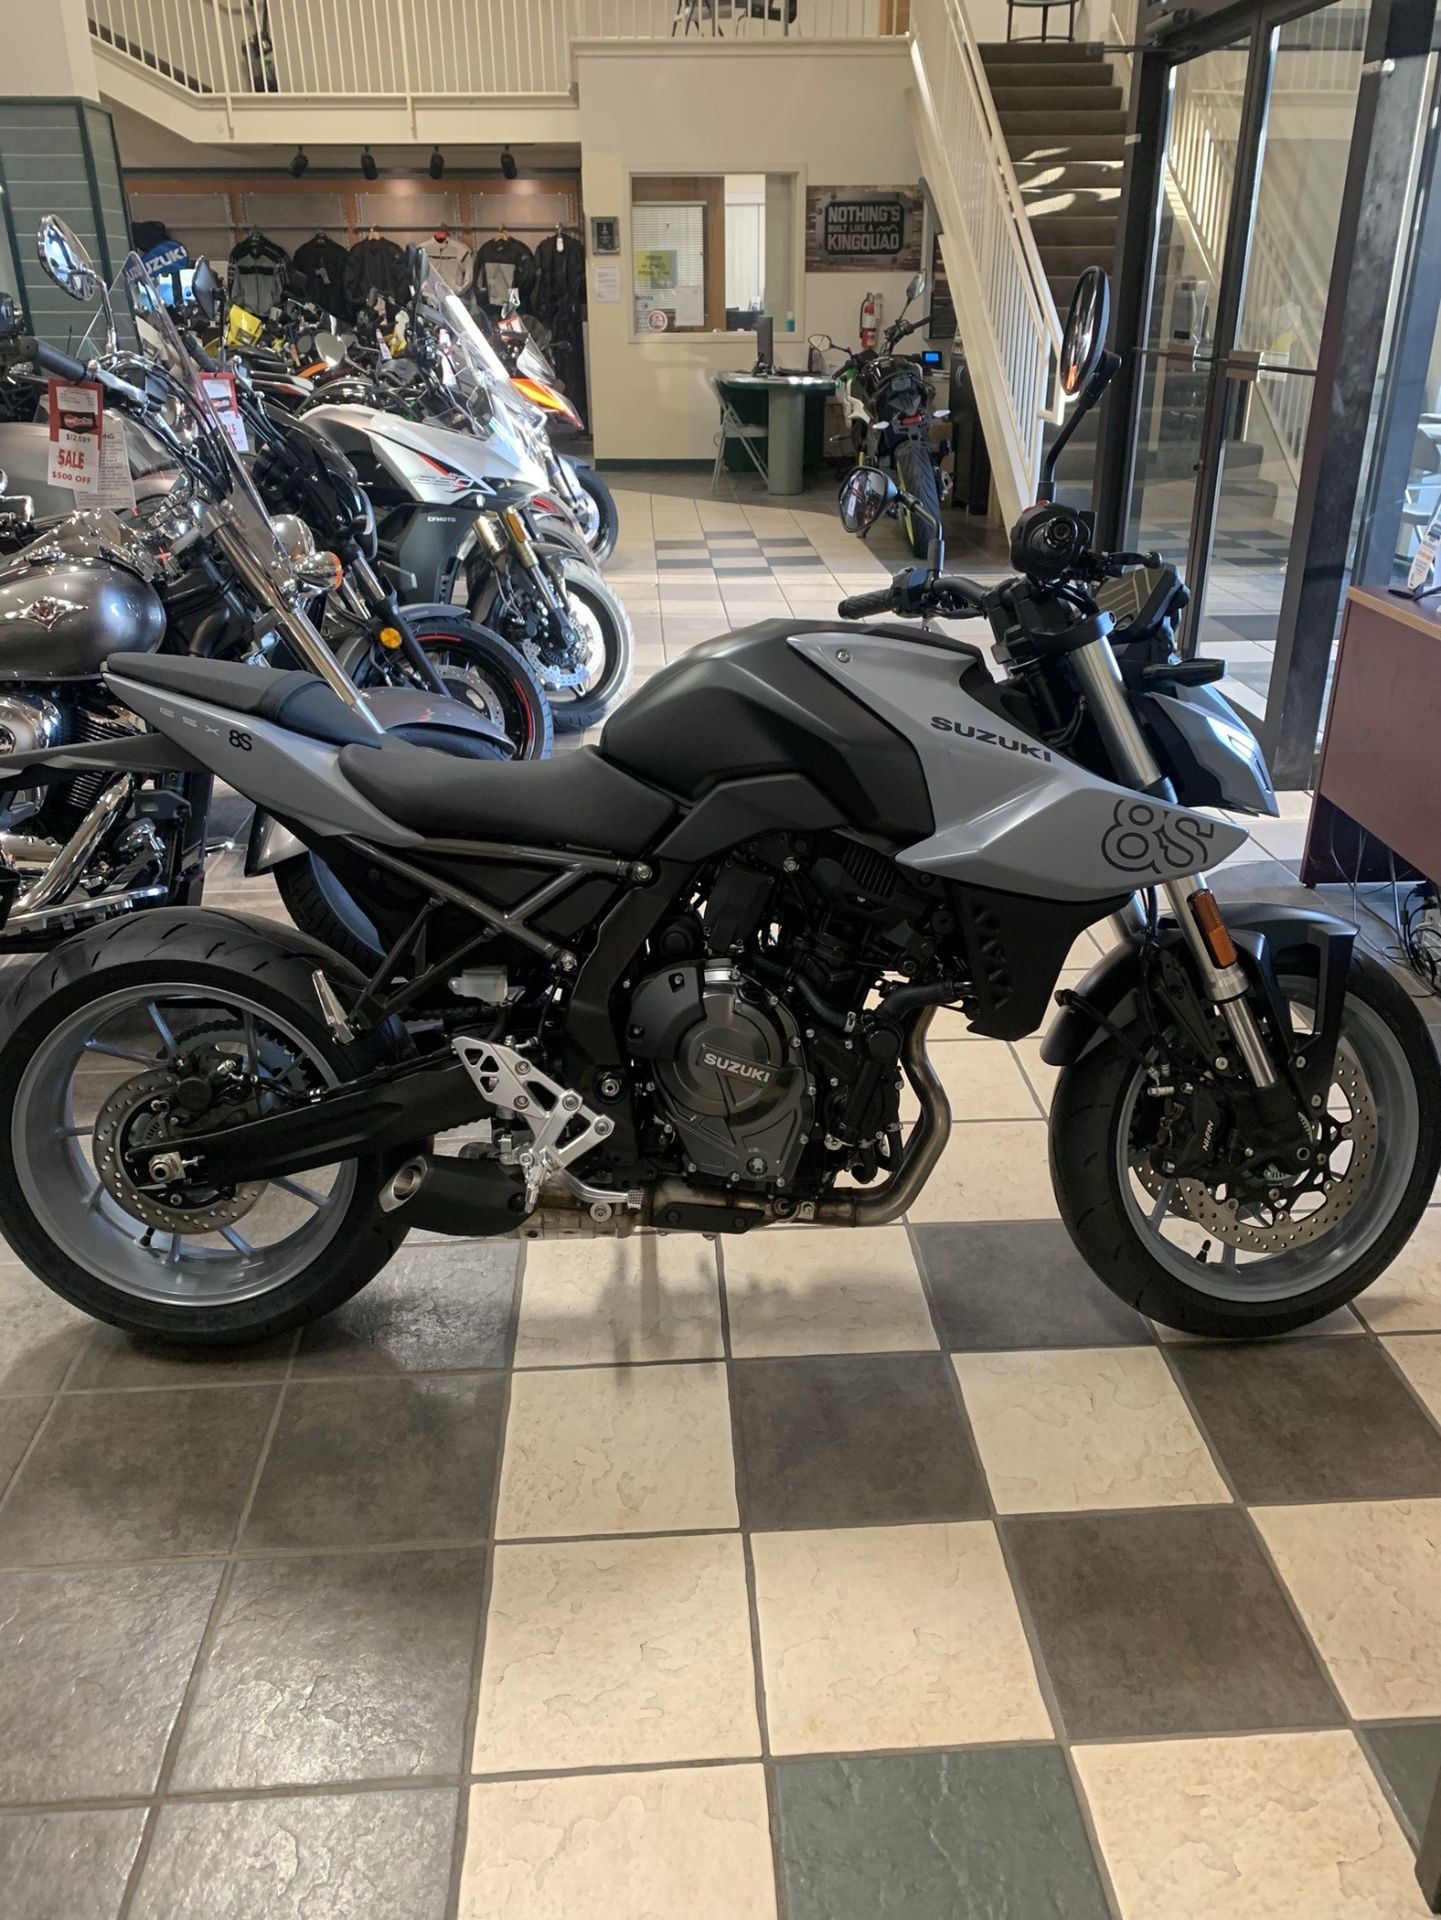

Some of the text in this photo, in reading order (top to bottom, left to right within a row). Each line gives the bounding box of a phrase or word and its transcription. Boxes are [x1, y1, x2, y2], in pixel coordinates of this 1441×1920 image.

[828, 205, 900, 222] NOTHING'S
[827, 224, 874, 233] BUILT LIKE A
[827, 233, 900, 251] KINGQUAD
[58, 449, 84, 469] SALE
[52, 471, 91, 484] $500 OFF
[228, 729, 253, 752] 8S
[930, 716, 1052, 763] SUZUKI
[703, 1053, 771, 1083] SUZUKI
